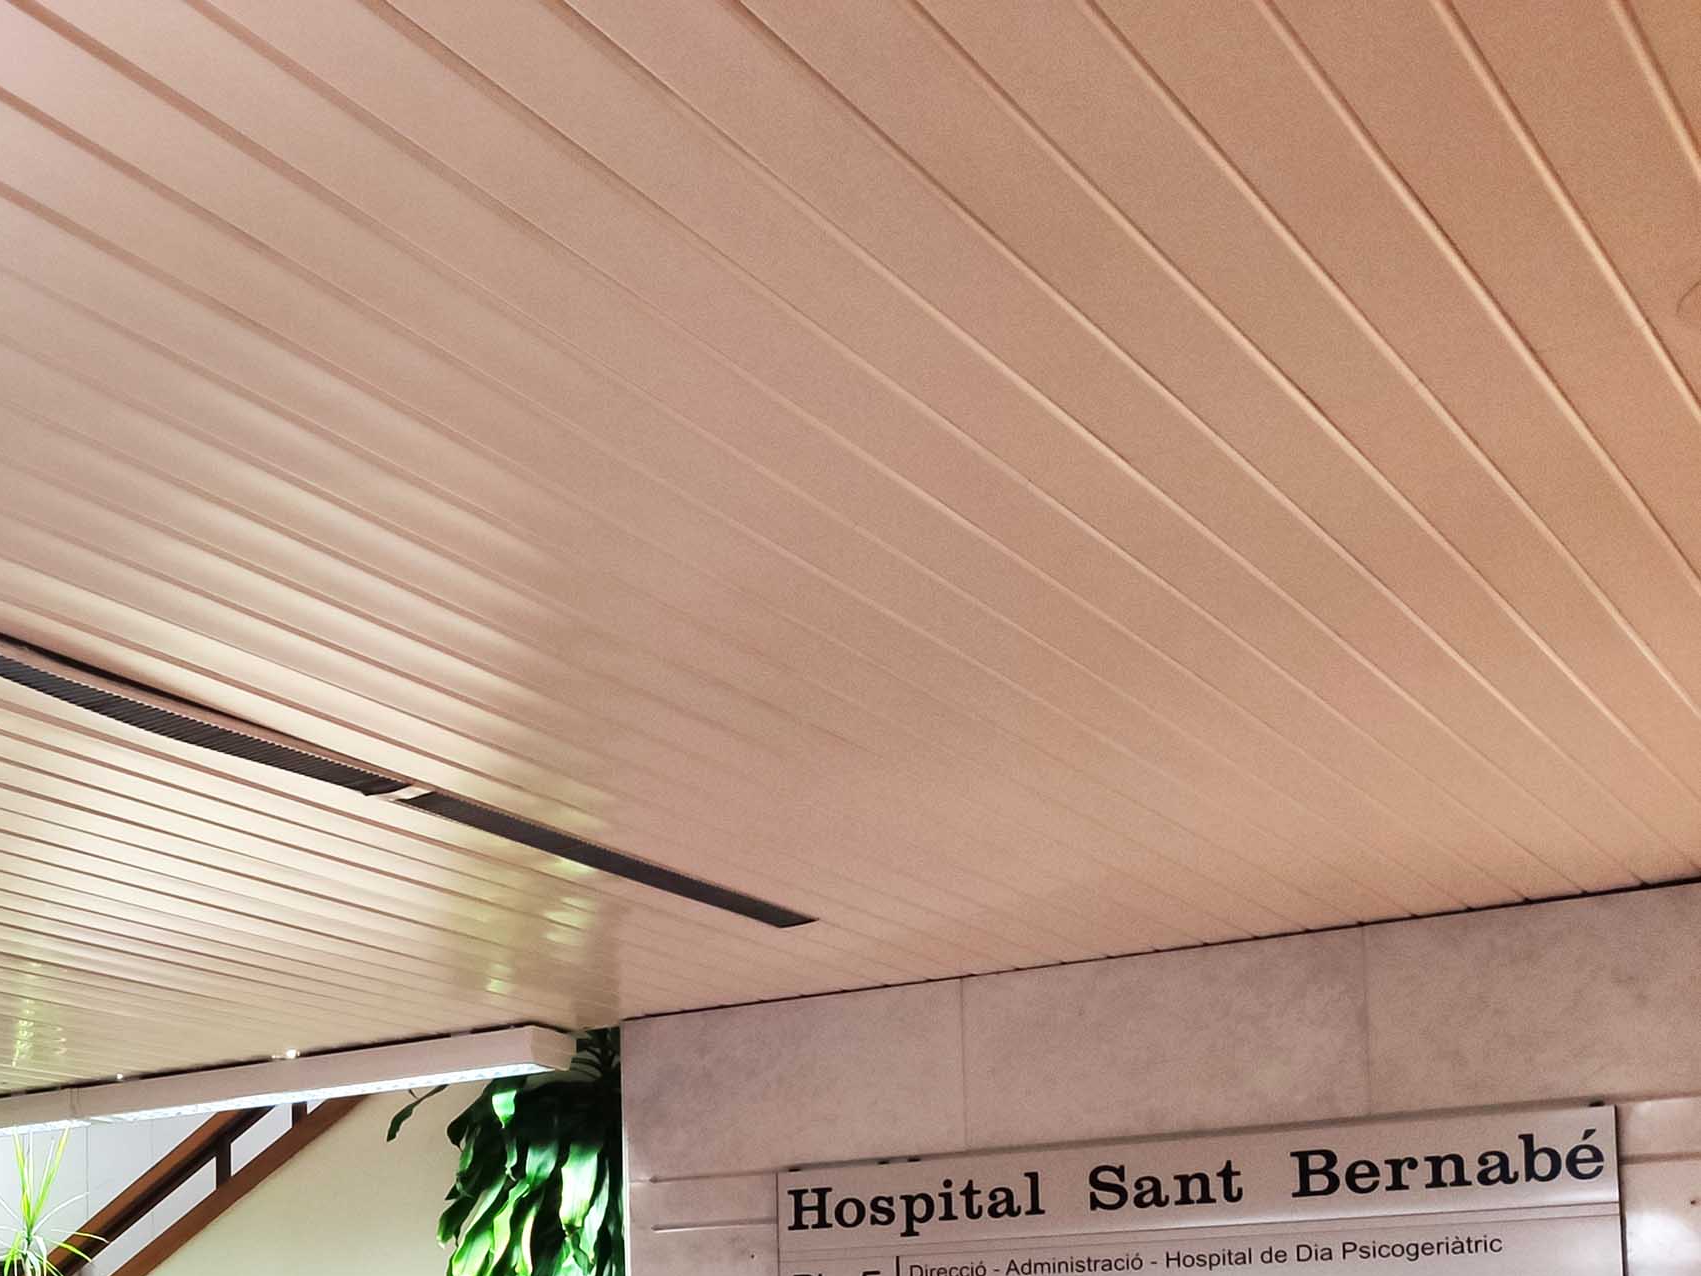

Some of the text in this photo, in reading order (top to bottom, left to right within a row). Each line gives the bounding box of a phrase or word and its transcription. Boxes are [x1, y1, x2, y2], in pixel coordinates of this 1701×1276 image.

[787, 1128, 1605, 1237] Hospital Sant Bernabé
[1005, 1255, 1144, 1276] Administració
[1165, 1247, 1253, 1271] Hospital
[1260, 1245, 1288, 1264] de
[1296, 1243, 1334, 1262] Dia
[1342, 1235, 1503, 1262] Psicogeriàtric
